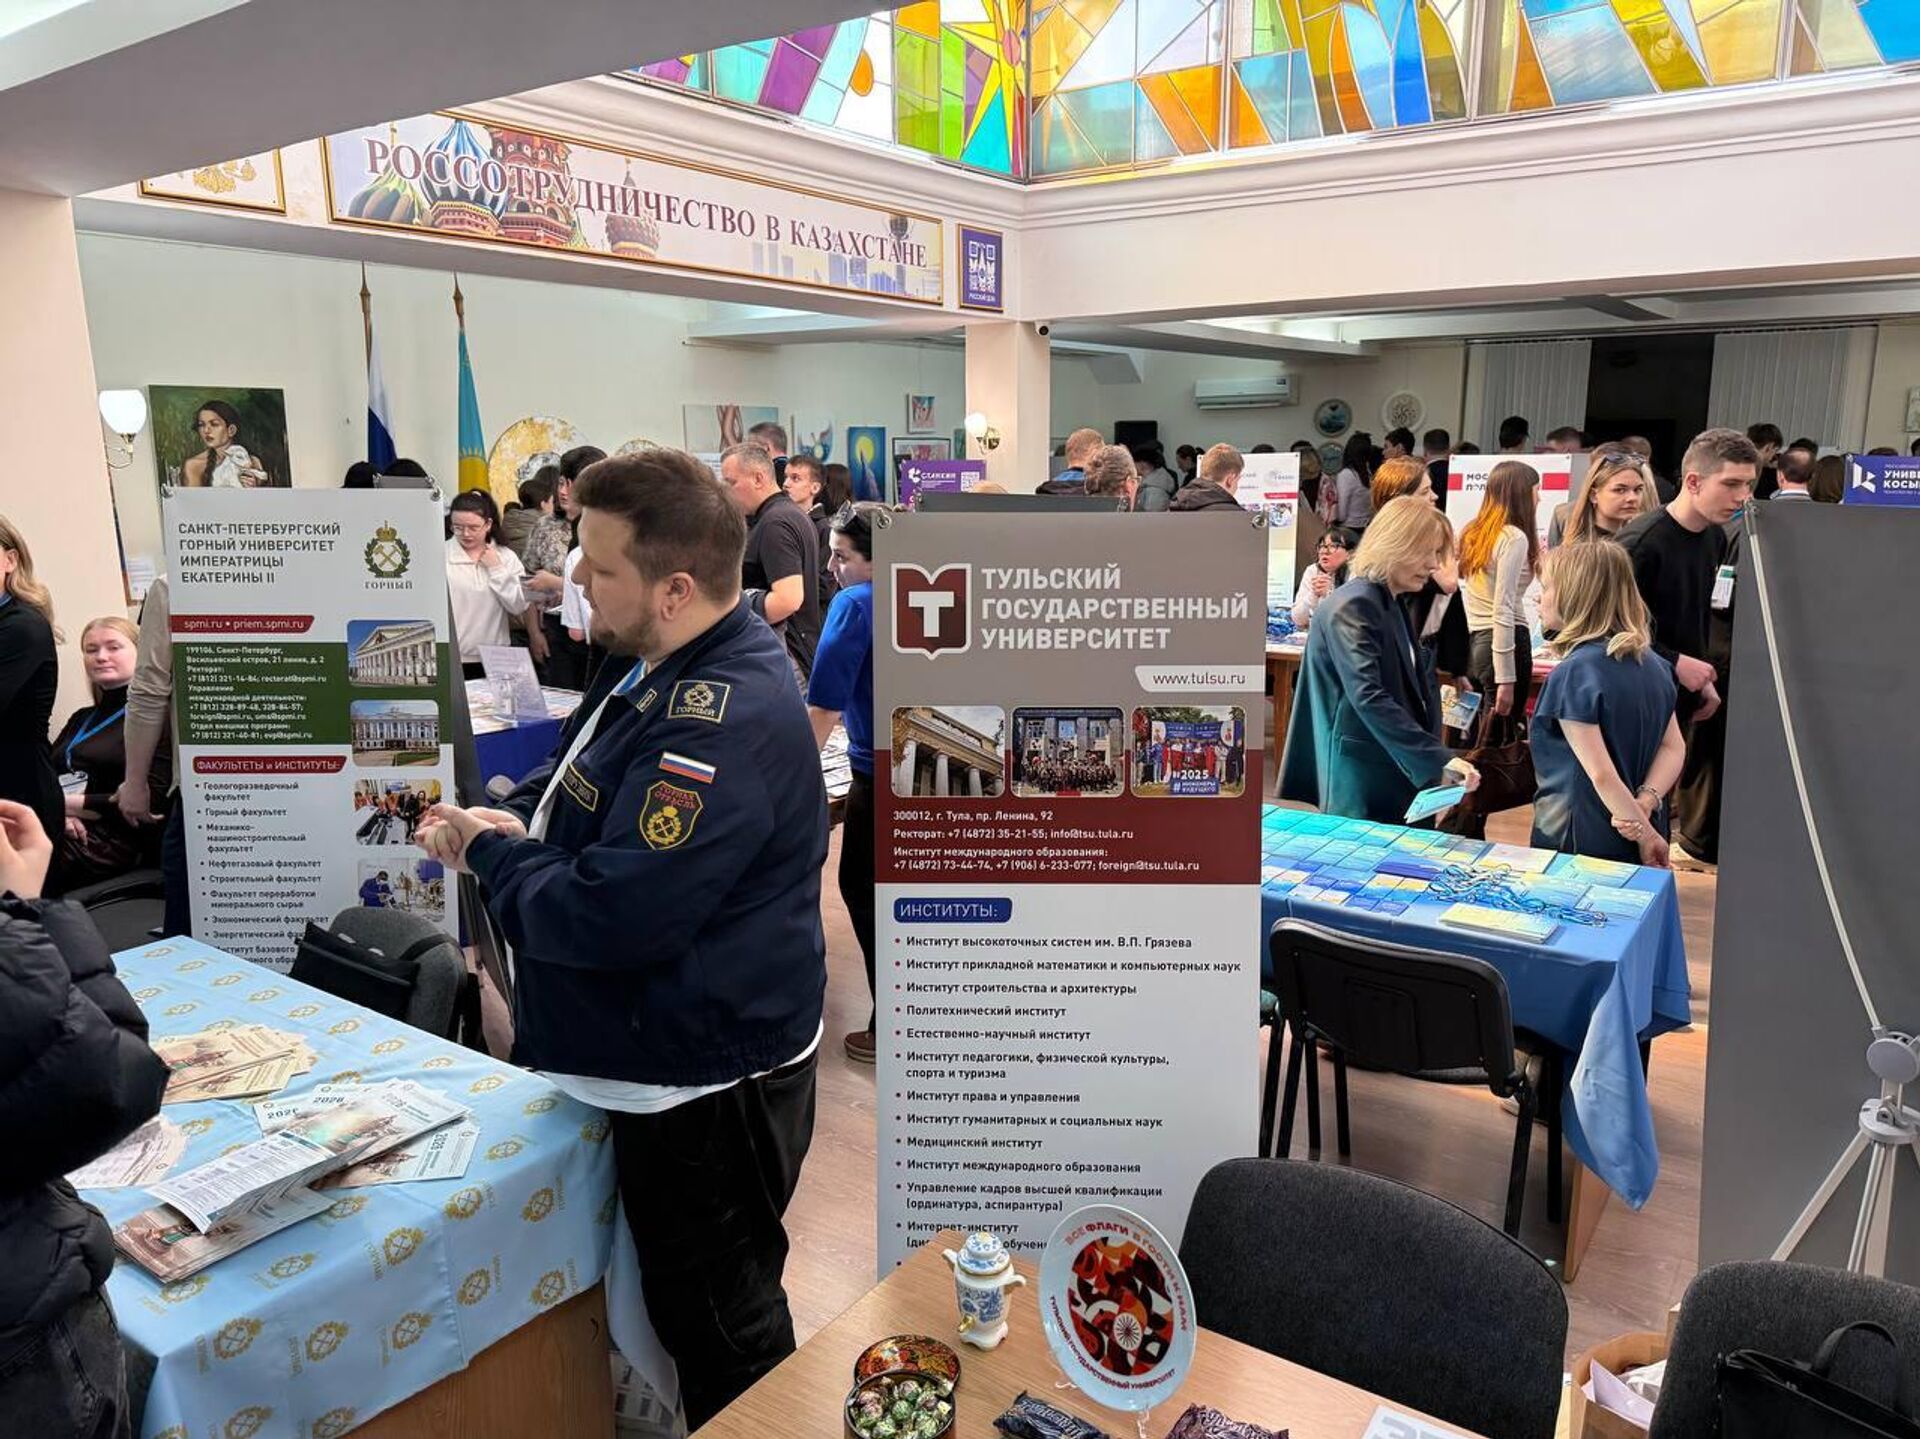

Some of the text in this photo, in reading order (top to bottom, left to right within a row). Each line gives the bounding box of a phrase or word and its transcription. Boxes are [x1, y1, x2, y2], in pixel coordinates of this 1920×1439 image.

[365, 137, 927, 268] РОССОТРУДНИЧЕСТВО В КАЗАХСТАНЕ
[1884, 480, 1920, 488] КОСЫ
[178, 522, 340, 535] САНКТ-ПЕТЕРБУРГСКИЙ
[180, 538, 334, 551] ГОРНЫЙ УНИВЕРСИТЕТ
[180, 556, 283, 568] ИМПЕРАТРИЦЫ
[182, 572, 274, 583] ЕКАТЕРИНЫ II
[981, 563, 1120, 589] ТУЛЬСКИЙ
[365, 581, 412, 589] ГОРНЫЙ
[982, 593, 1248, 623] ГОСУДАРСТВЕННЫЙ
[184, 620, 223, 630] spmi.ru
[233, 619, 304, 630] priem.spmi.ru
[982, 628, 1171, 649] УНИВЕРСИТЕТ
[216, 646, 283, 654] Санкт-Петербург,
[1153, 672, 1245, 684] www.tulsu.ru
[676, 706, 716, 717] ГОРНЫЙ
[197, 761, 264, 770] ФАКУЛЬТЕТЫ
[275, 761, 340, 770] ИНСТИТУТЫ:
[203, 782, 299, 791] Геологоразведочный
[204, 793, 250, 802] факультет
[205, 808, 286, 817] Горный факультет
[894, 811, 933, 821] 300012,
[946, 811, 974, 822] Тула,
[976, 813, 992, 822] пр.
[995, 811, 1038, 821] Ленина,
[1040, 811, 1053, 820] 92
[207, 834, 306, 843] машиностроительный
[894, 829, 945, 840] Ректорат:
[948, 829, 960, 838] +7
[997, 829, 1048, 839] 35-21-55;
[1050, 829, 1133, 838] info@tsu.tula.ru
[207, 845, 253, 854] факультет
[894, 847, 1108, 858] Институт международного образования:
[208, 860, 321, 869] Нефтегазовый факультет
[894, 860, 906, 869] +7
[943, 860, 993, 870] 73-44-74,
[996, 860, 1008, 869] +7
[1039, 860, 1096, 870] 6-233-077;
[1098, 860, 1199, 872] foreign@tsu.tula.ru
[209, 875, 321, 884] Строительный факультет
[210, 890, 316, 899] Факультет переработки
[900, 904, 997, 917] ИНСТИТУТЫ:
[213, 931, 285, 939] Энергетический
[255, 944, 295, 953] базового
[907, 936, 959, 948] Институт
[962, 938, 1048, 946] высокоточных
[1118, 937, 1141, 947] В.П.
[1145, 937, 1192, 949] Грязева
[907, 959, 960, 971] Институт
[962, 960, 1034, 971] прикладной
[1037, 962, 1107, 970] математики
[1121, 962, 1210, 973] компьютерных
[1213, 964, 1240, 973] наук
[907, 982, 960, 994] Институт
[962, 985, 1047, 995] строительства
[1060, 986, 1136, 996] архитектуры
[907, 1005, 1066, 1018] Политехнический институт
[907, 1028, 1090, 1042] Естественно-научный институт
[907, 1051, 1169, 1066] Институт педагогики, физической культуры,
[906, 1070, 945, 1079] спорта
[958, 1070, 1006, 1080] туризма
[907, 1091, 959, 1102] Институт
[963, 1093, 997, 1103] права
[1010, 1094, 1080, 1104] управления
[907, 1114, 960, 1125] Институт
[963, 1116, 1047, 1126] гуманитарных
[1060, 1118, 1132, 1127] социальных
[1135, 1119, 1162, 1129] наук
[907, 1137, 1042, 1150] Медицинский институт
[907, 1160, 1140, 1174] Институт международного образования
[907, 1182, 1162, 1198] Управление кадров высшей квалификации
[907, 1221, 1018, 1234] Интернет-институт
[1086, 1222, 1129, 1236] ФЛАГИ
